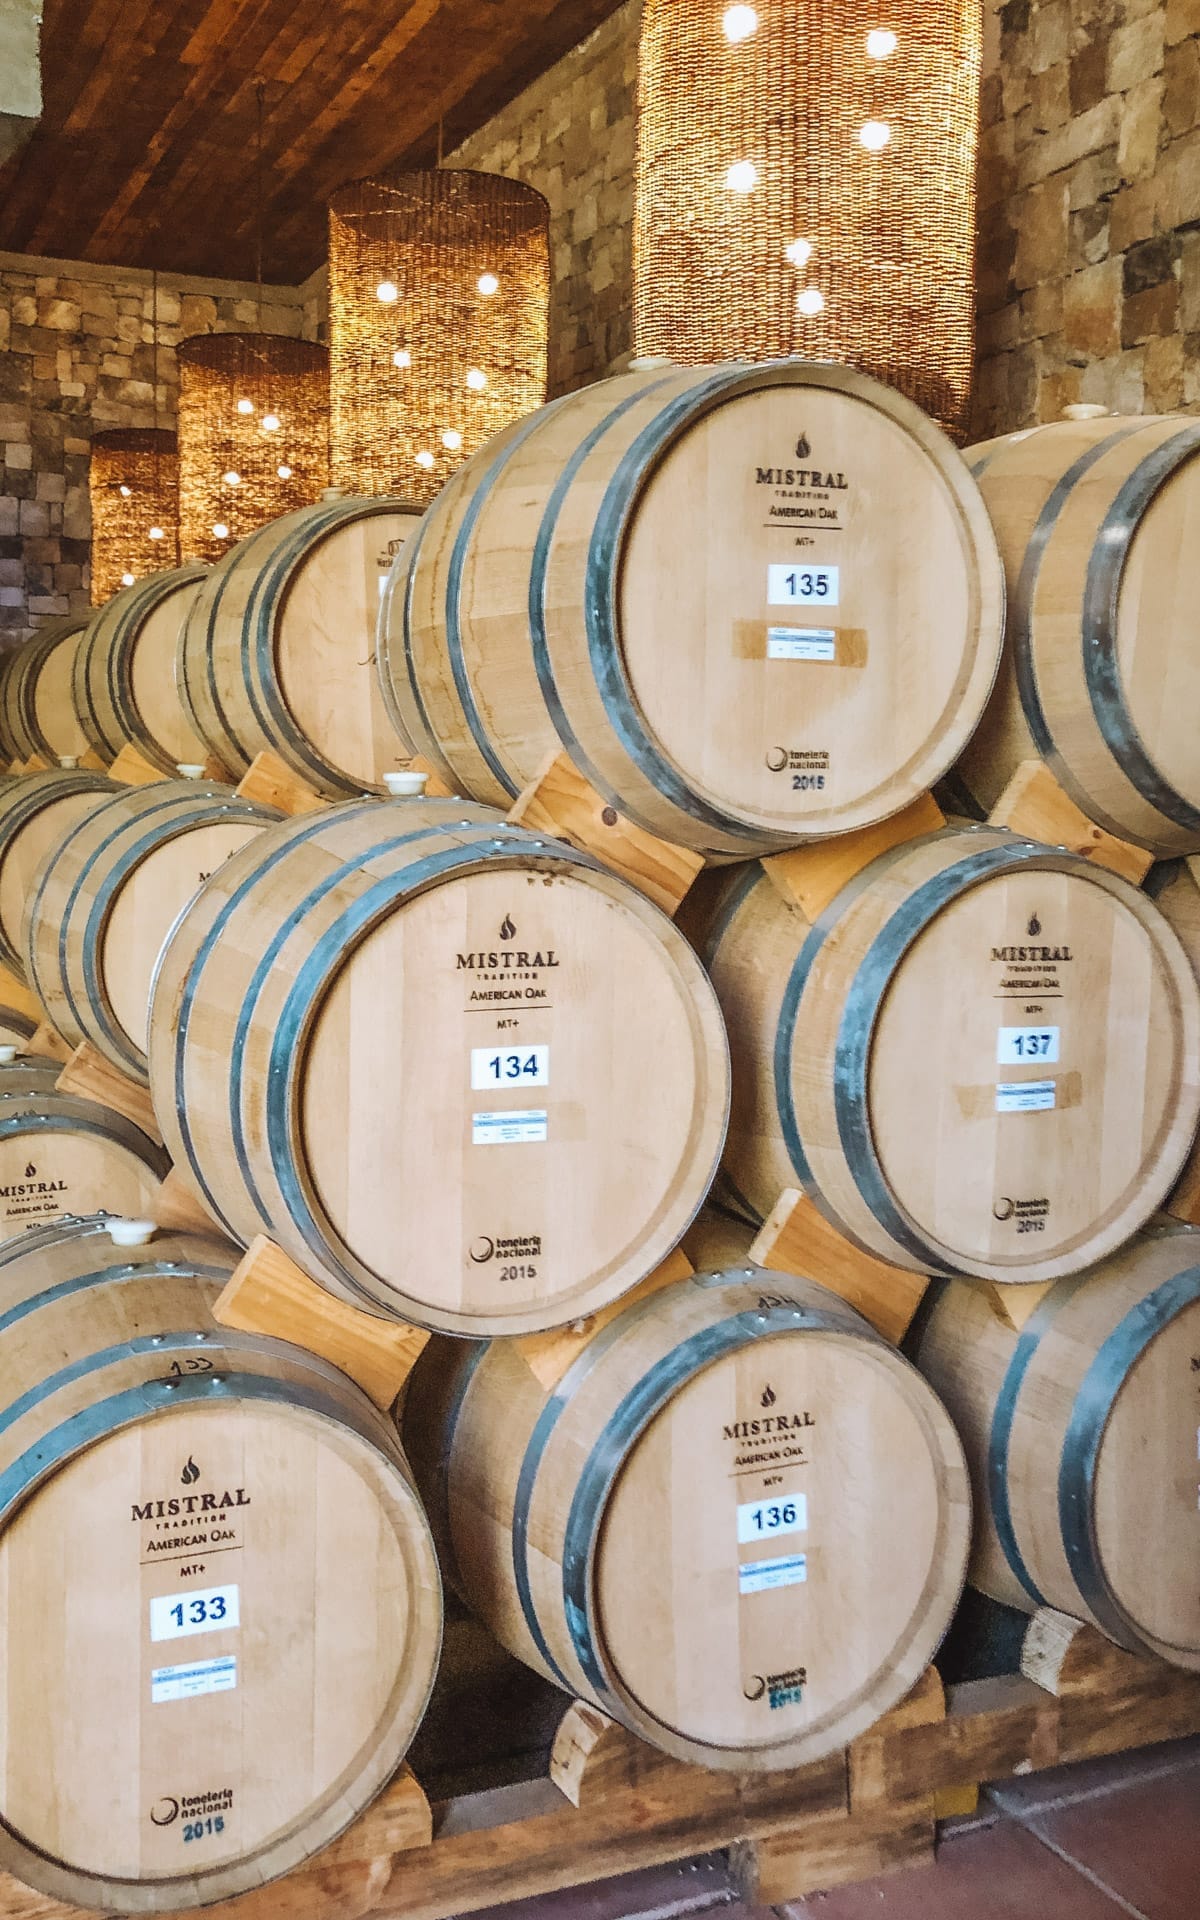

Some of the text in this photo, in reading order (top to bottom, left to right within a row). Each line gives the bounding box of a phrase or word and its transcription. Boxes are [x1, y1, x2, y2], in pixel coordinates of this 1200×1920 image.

[755, 467, 848, 489] MISTRAL
[785, 573, 829, 596] 135
[792, 775, 825, 790] 2015
[456, 951, 560, 970] MISTRAL
[991, 946, 1073, 961] MISTRAL
[470, 987, 547, 1001] AMERICAN OAK
[497, 1019, 519, 1029] MT+
[1014, 1034, 1052, 1055] 137
[489, 1054, 538, 1079] 134
[0, 1180, 68, 1197] MISTRAL
[496, 1245, 541, 1258] nacional
[499, 1264, 537, 1281] 2015
[722, 1411, 816, 1440] MISTRAL
[131, 1489, 251, 1521] MISTRAL
[156, 1514, 227, 1531] TRADITION
[752, 1503, 797, 1531] 136
[146, 1529, 236, 1553] AMERICAN OAK
[180, 1564, 206, 1577] MT+
[170, 1596, 227, 1627] 133
[181, 1798, 233, 1819] nacional
[183, 1816, 225, 1842] 2015
